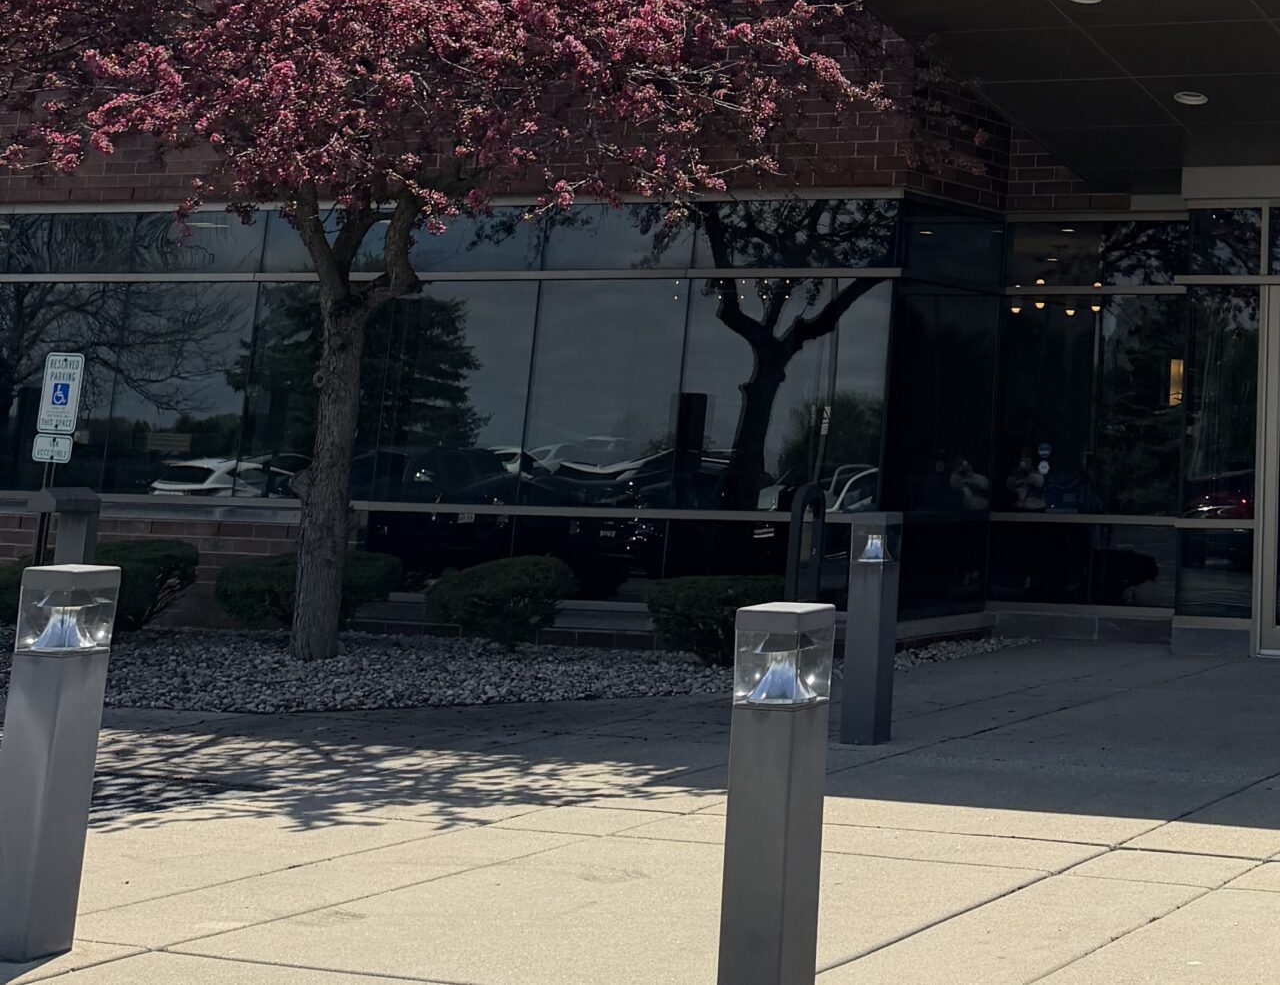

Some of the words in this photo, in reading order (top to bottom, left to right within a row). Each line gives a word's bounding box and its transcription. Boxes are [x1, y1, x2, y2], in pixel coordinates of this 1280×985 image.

[50, 358, 80, 370] RESERVED
[50, 371, 77, 383] PARKING
[55, 418, 72, 428] SPACE
